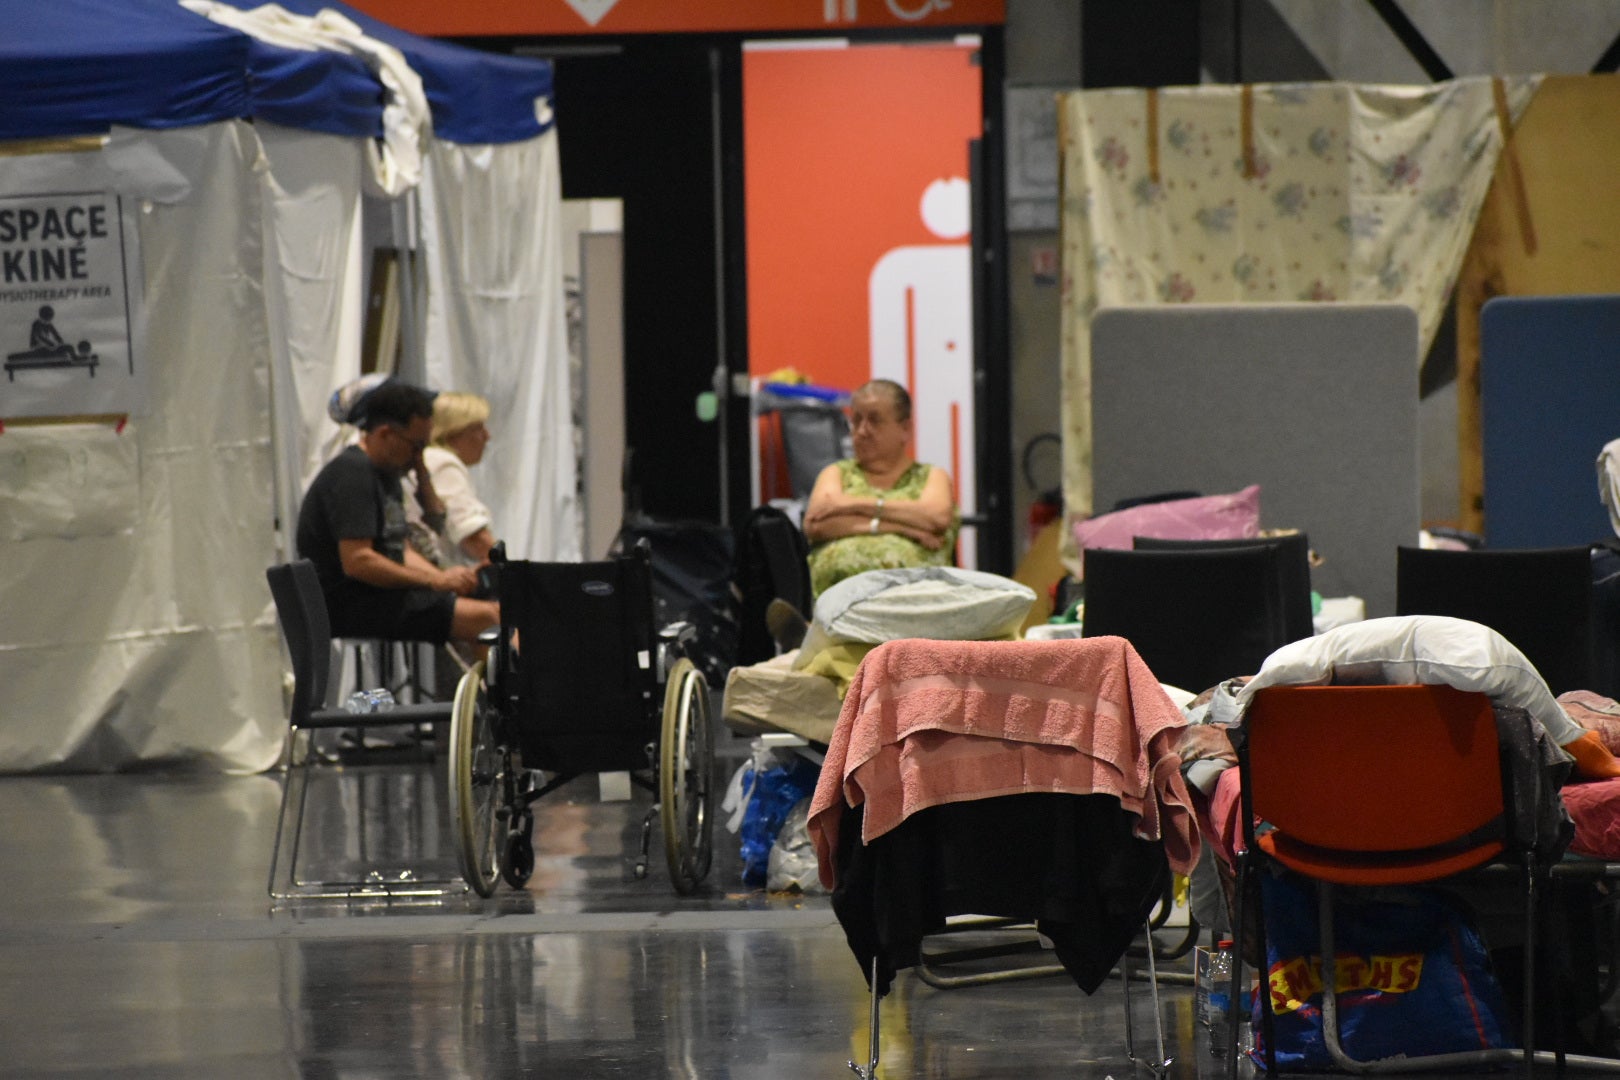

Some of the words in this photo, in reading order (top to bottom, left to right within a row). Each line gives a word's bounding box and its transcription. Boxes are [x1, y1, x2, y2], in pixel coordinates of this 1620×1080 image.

[0, 205, 108, 243] SPACE
[3, 240, 89, 283] KINÉ
[0, 288, 79, 302] YSIOTHERAPY
[83, 286, 112, 298] AREA
[1269, 957, 1420, 1010] SMTHS
